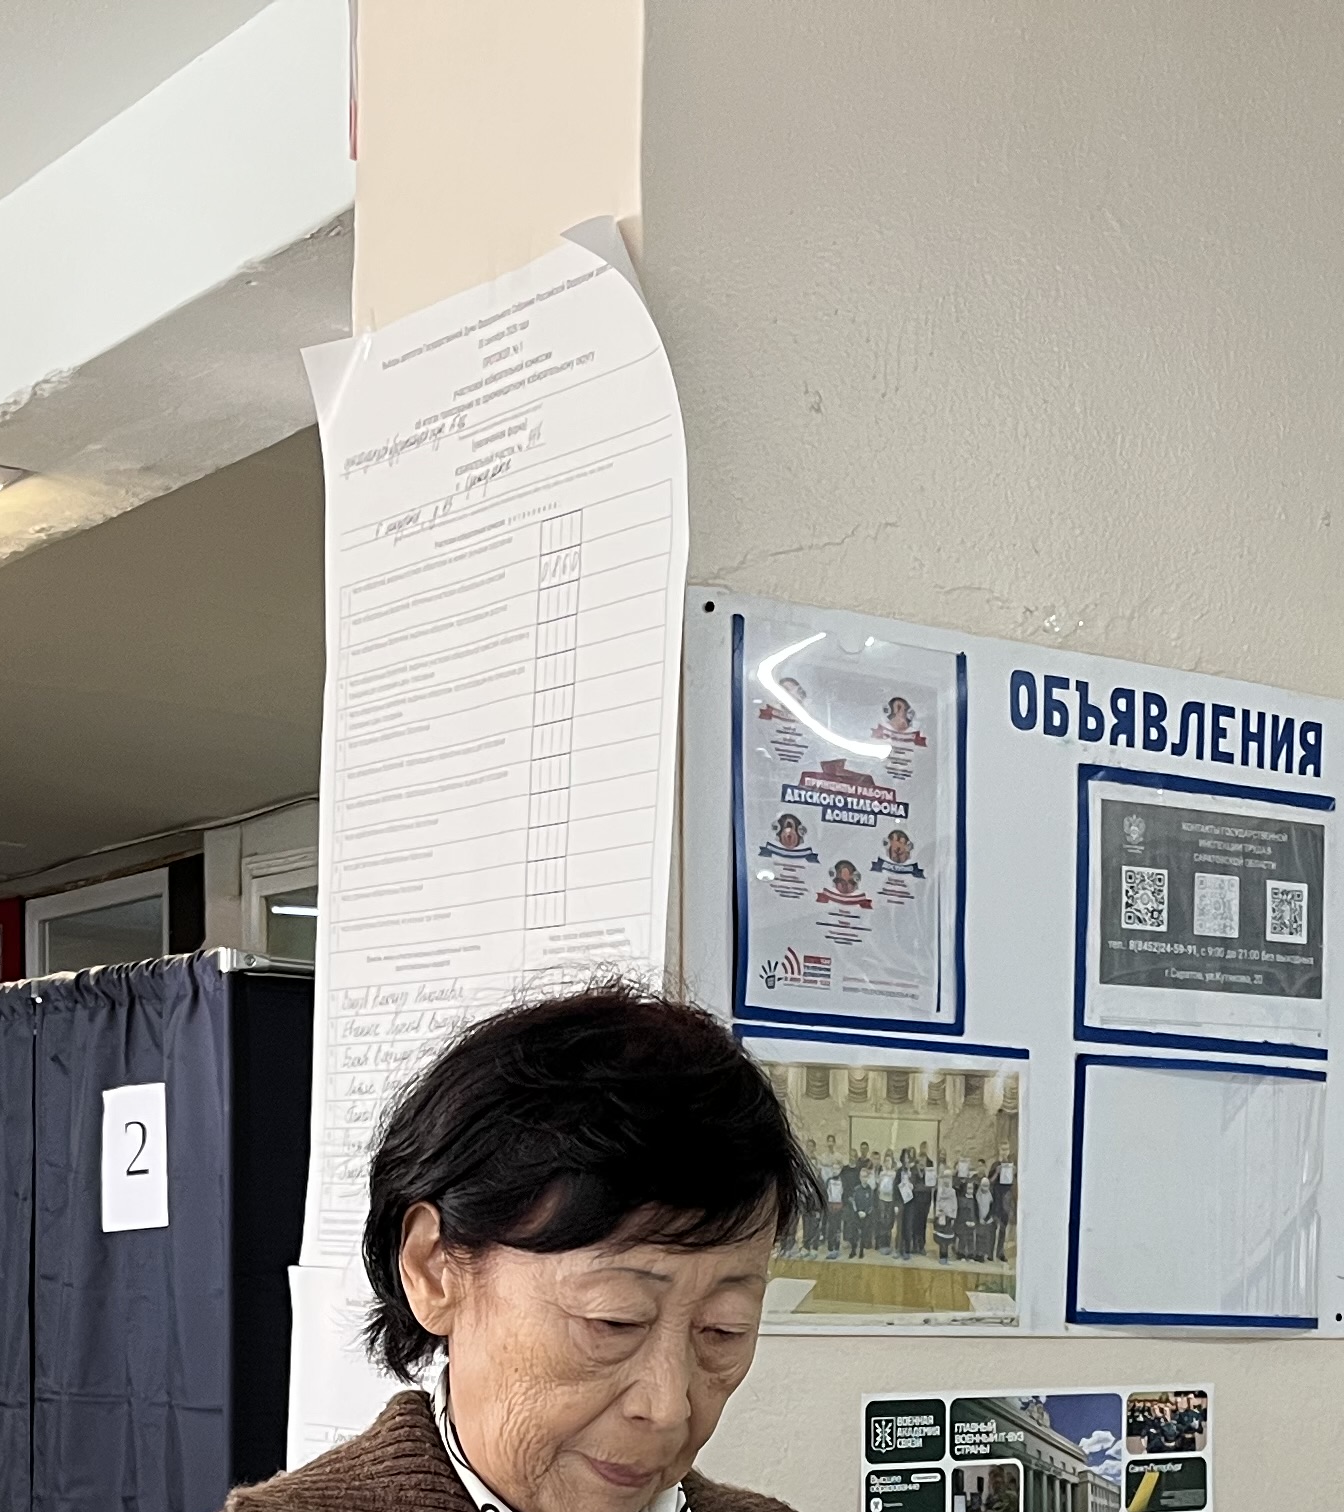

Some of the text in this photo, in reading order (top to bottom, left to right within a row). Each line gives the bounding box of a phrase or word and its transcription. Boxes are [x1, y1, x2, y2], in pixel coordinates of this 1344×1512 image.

[1009, 669, 1324, 778] ОБЪЯВЛЕНИЯ
[804, 777, 894, 801] ПРИНЦИПЫ РАБОТЫ
[785, 788, 906, 817] ДЕТСКОГО ТЕЛЕФОНА
[825, 809, 876, 827] ДОВЕРИЯ
[124, 1121, 150, 1176] 2
[897, 1415, 934, 1427] ВОЕННАЯ
[954, 1419, 997, 1434] ГЛАВНЫЙ
[897, 1425, 941, 1437] АКАДЕМИЯ
[954, 1432, 997, 1444] ВОЕННЫЙ
[954, 1444, 991, 1456] СТРАНЫ
